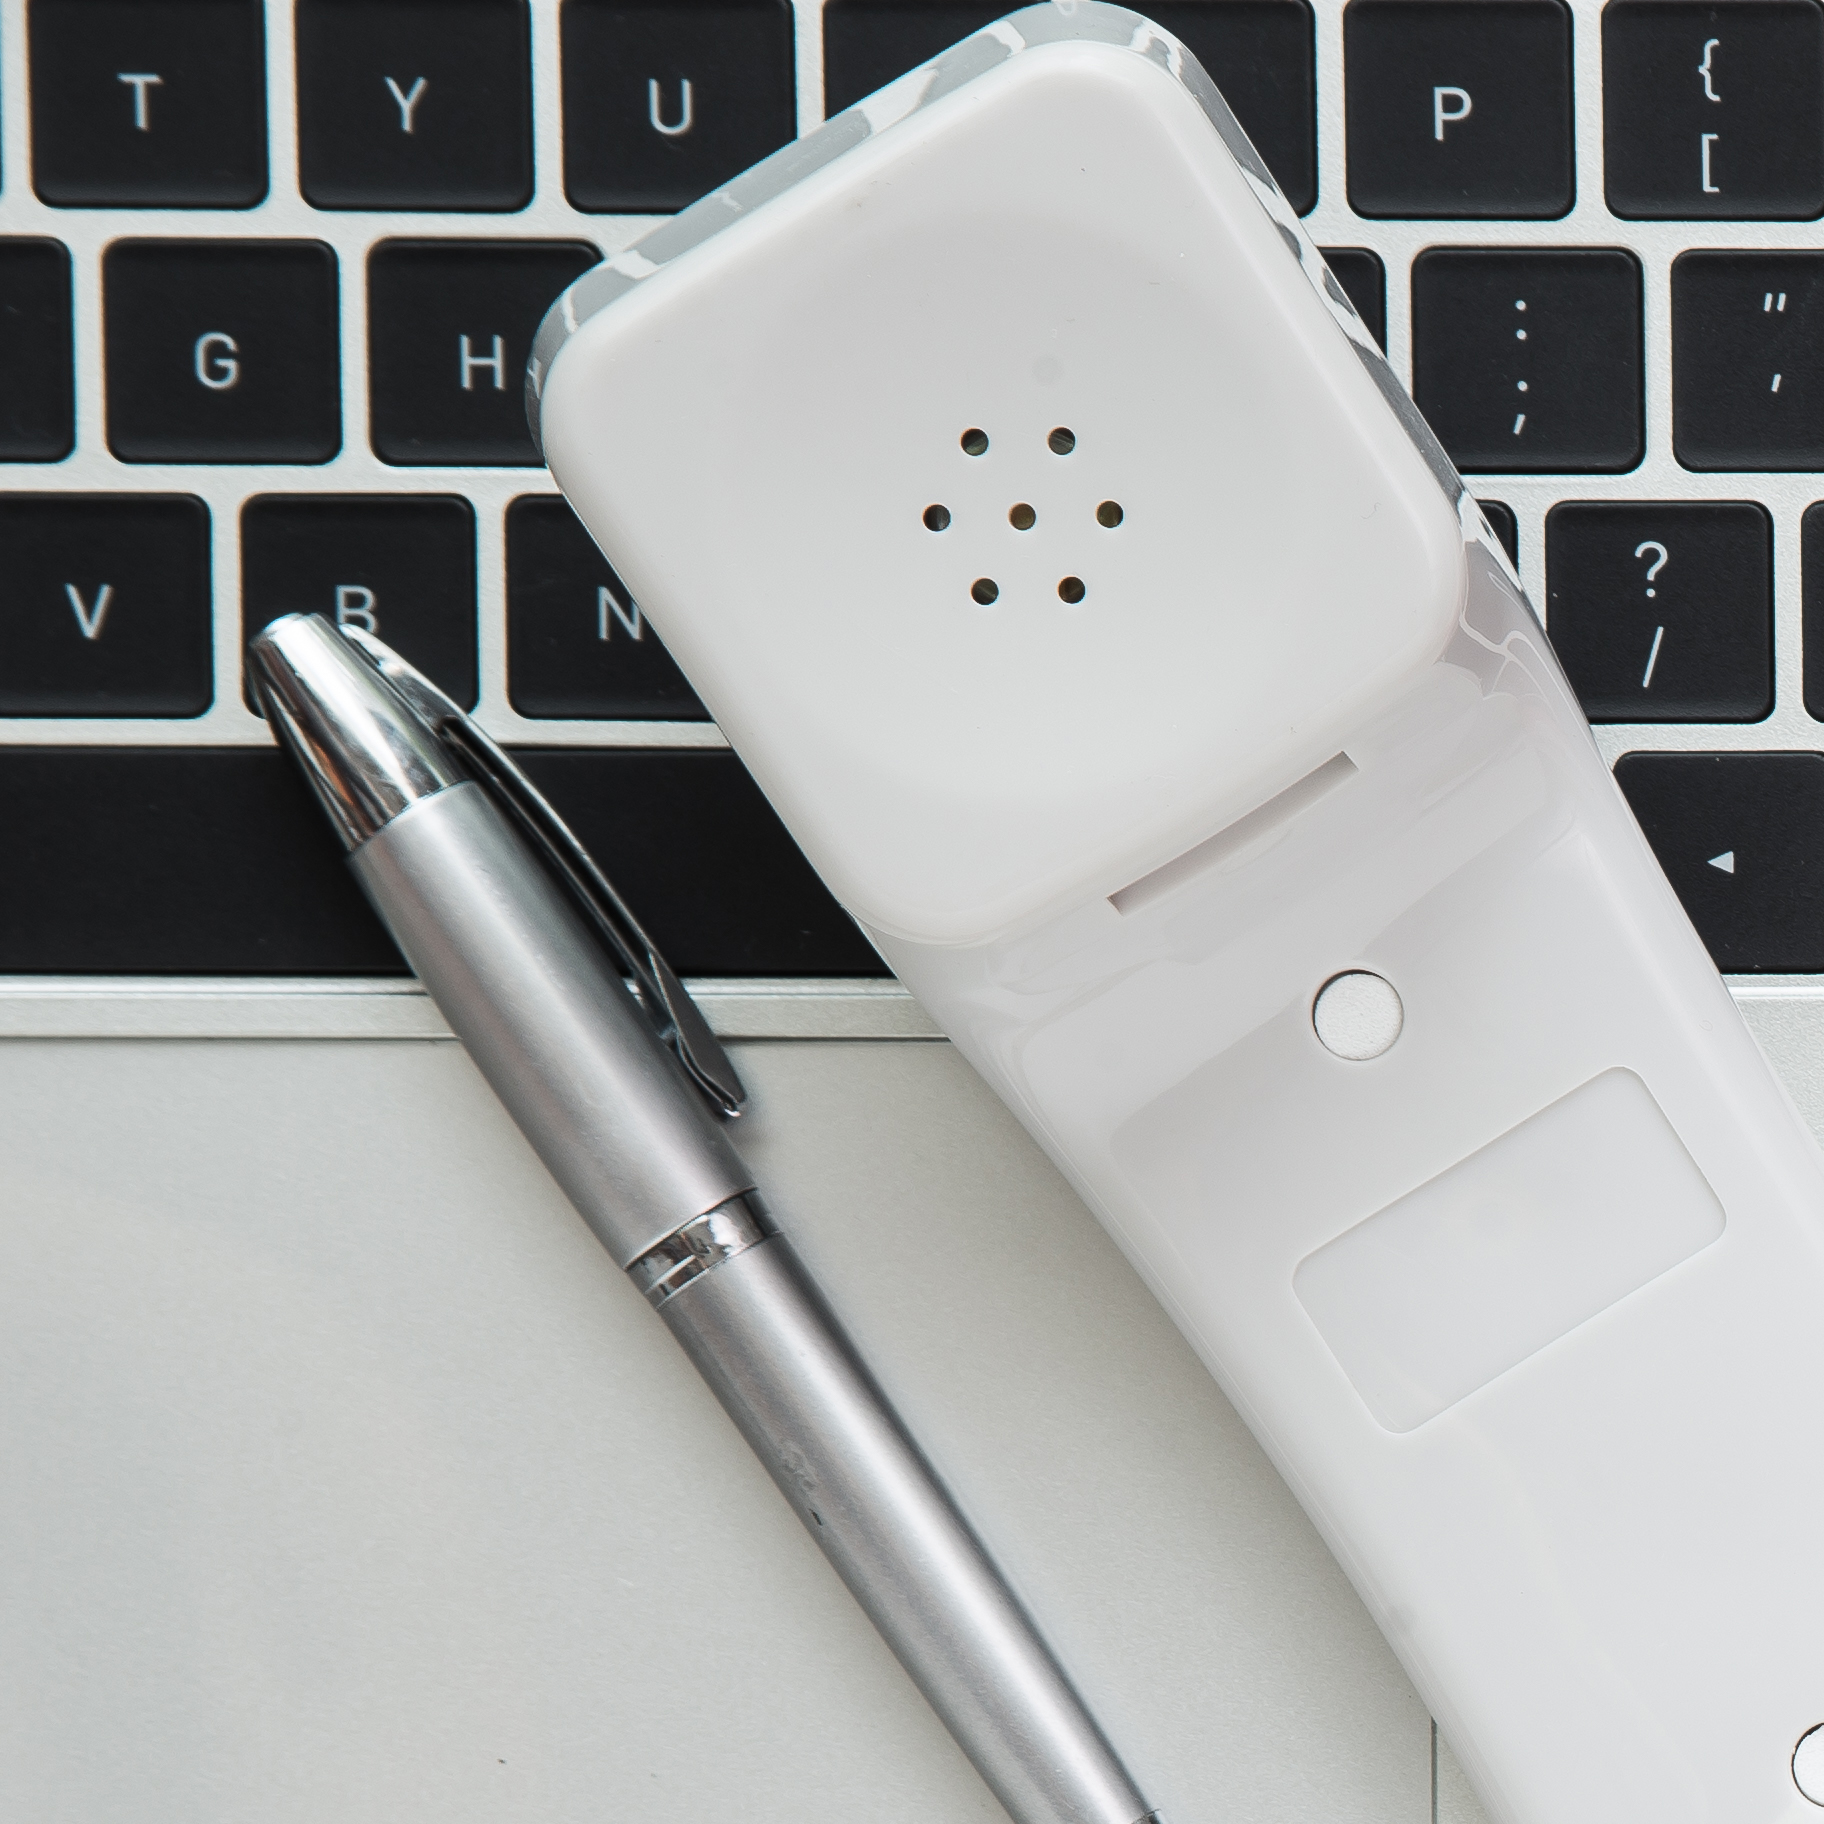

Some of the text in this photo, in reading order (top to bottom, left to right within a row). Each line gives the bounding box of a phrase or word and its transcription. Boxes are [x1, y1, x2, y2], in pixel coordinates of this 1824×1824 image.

[1698, 38, 1721, 102] {
[119, 74, 161, 129] T
[386, 77, 426, 132] Y
[649, 79, 692, 135] U
[1434, 86, 1472, 141] P
[1701, 133, 1720, 193] [
[195, 332, 238, 389] G
[460, 335, 504, 390] H
[1634, 540, 1669, 598] ?
[66, 584, 111, 639] V
[335, 585, 379, 634] B
[598, 586, 643, 642] N
